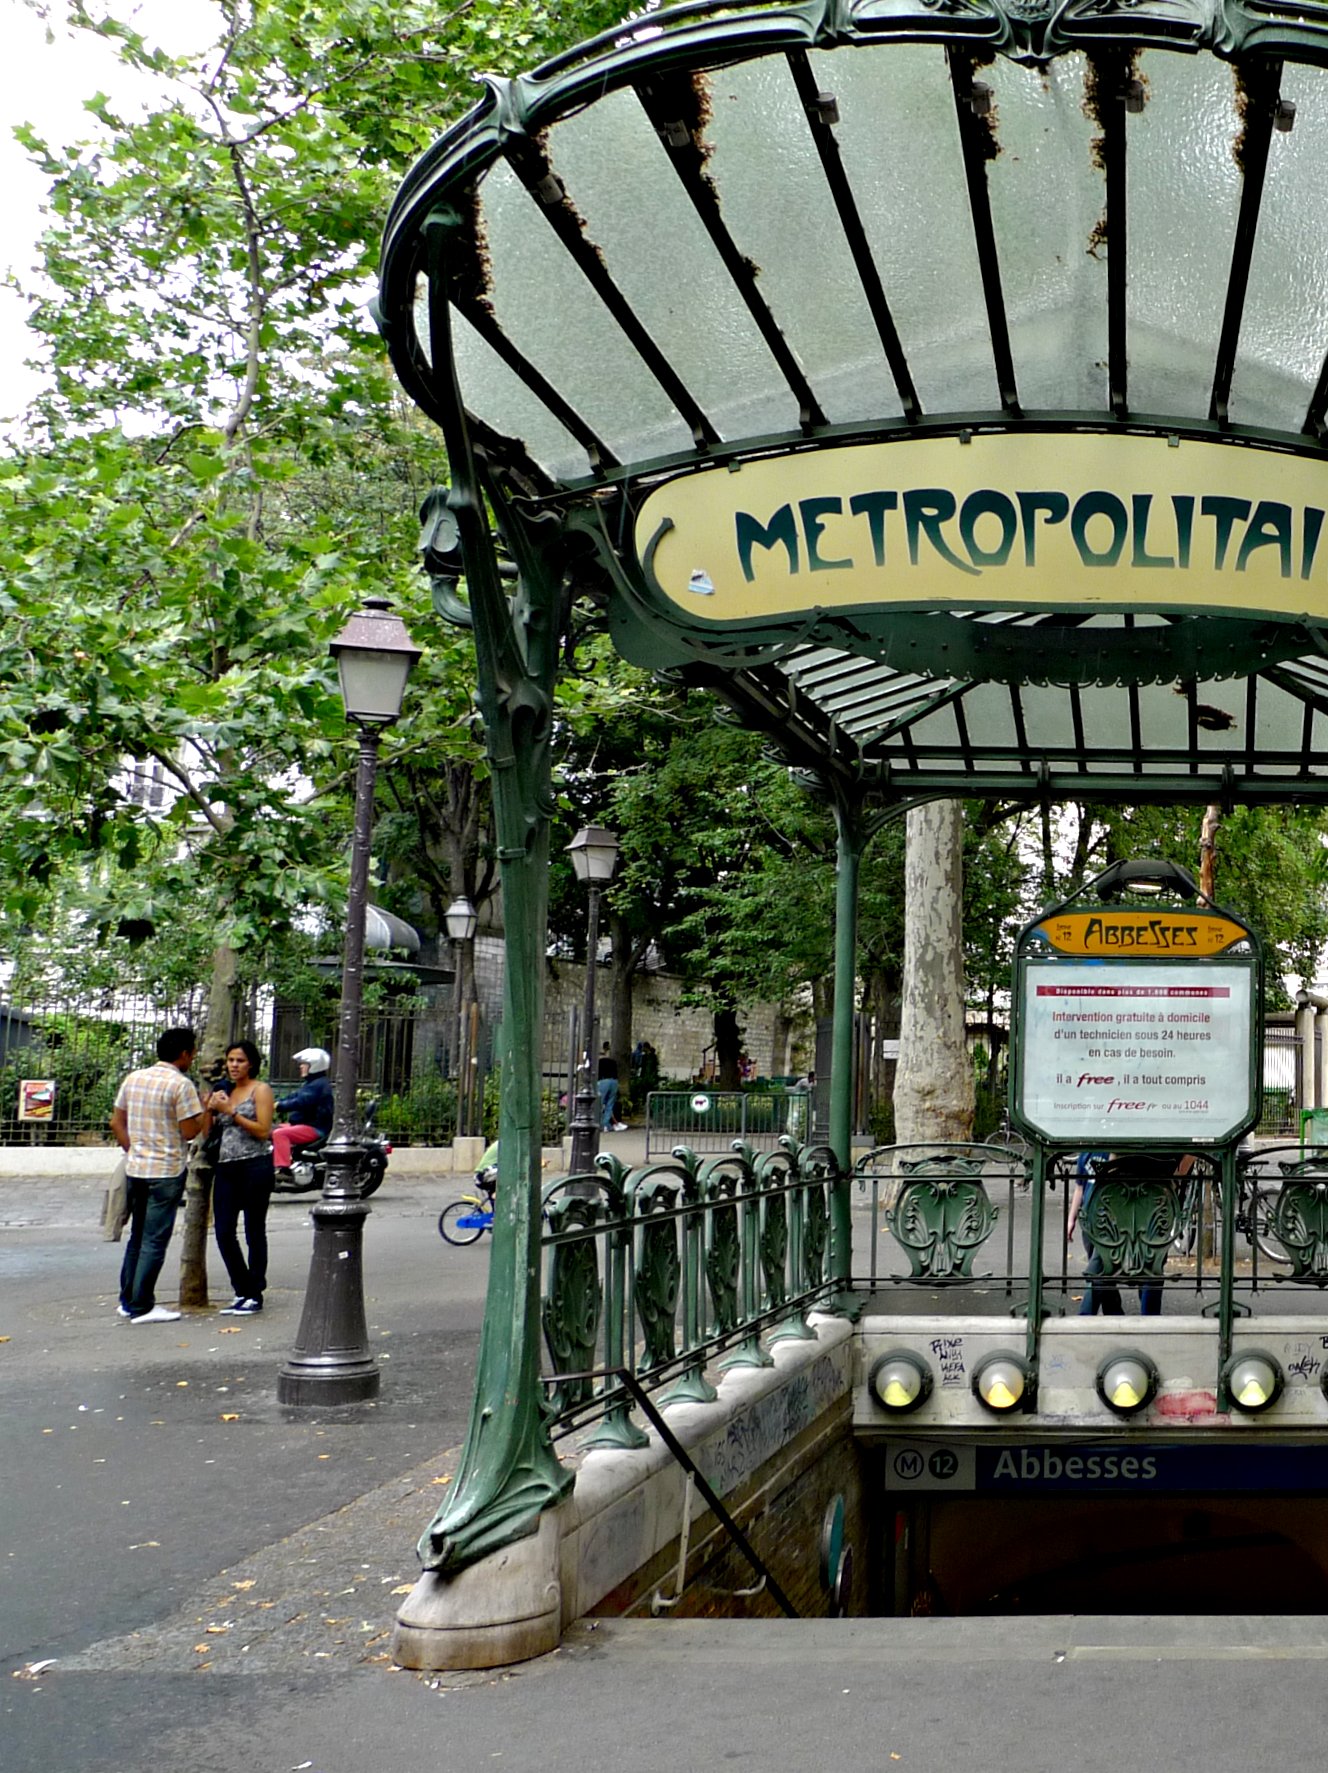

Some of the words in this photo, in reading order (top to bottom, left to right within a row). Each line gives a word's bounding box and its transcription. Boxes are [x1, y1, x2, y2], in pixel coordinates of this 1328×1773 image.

[1063, 931, 1072, 941] 12
[1084, 917, 1198, 949] ABBESSES
[1052, 1011, 1113, 1023] Intervention
[1115, 1012, 1155, 1025] gratuite
[1157, 1012, 1164, 1023] à
[1167, 1012, 1210, 1023] domicile
[1054, 1029, 1077, 1040] d'un
[1079, 1029, 1132, 1041] technicien
[1134, 1031, 1159, 1041] sous
[1161, 1030, 1174, 1041] 24
[1176, 1030, 1211, 1041] heures
[1088, 1049, 1101, 1058] en
[1104, 1049, 1122, 1058] cas
[1124, 1047, 1137, 1058] de
[1139, 1047, 1176, 1058] besoin.
[1056, 1073, 1063, 1084] il
[1065, 1075, 1072, 1084] a
[1076, 1072, 1115, 1088] free
[1123, 1073, 1130, 1084] il
[1132, 1075, 1139, 1084] a
[1142, 1074, 1162, 1085] tout
[1164, 1074, 1206, 1088] compris
[1053, 1101, 1092, 1111] Inscription
[1107, 1097, 1146, 1113] free
[1161, 1103, 1171, 1111] ou
[1172, 1103, 1182, 1111] au
[1184, 1100, 1209, 1110] 1044
[932, 1455, 954, 1474] 12
[993, 1449, 1157, 1480] Abbesses
